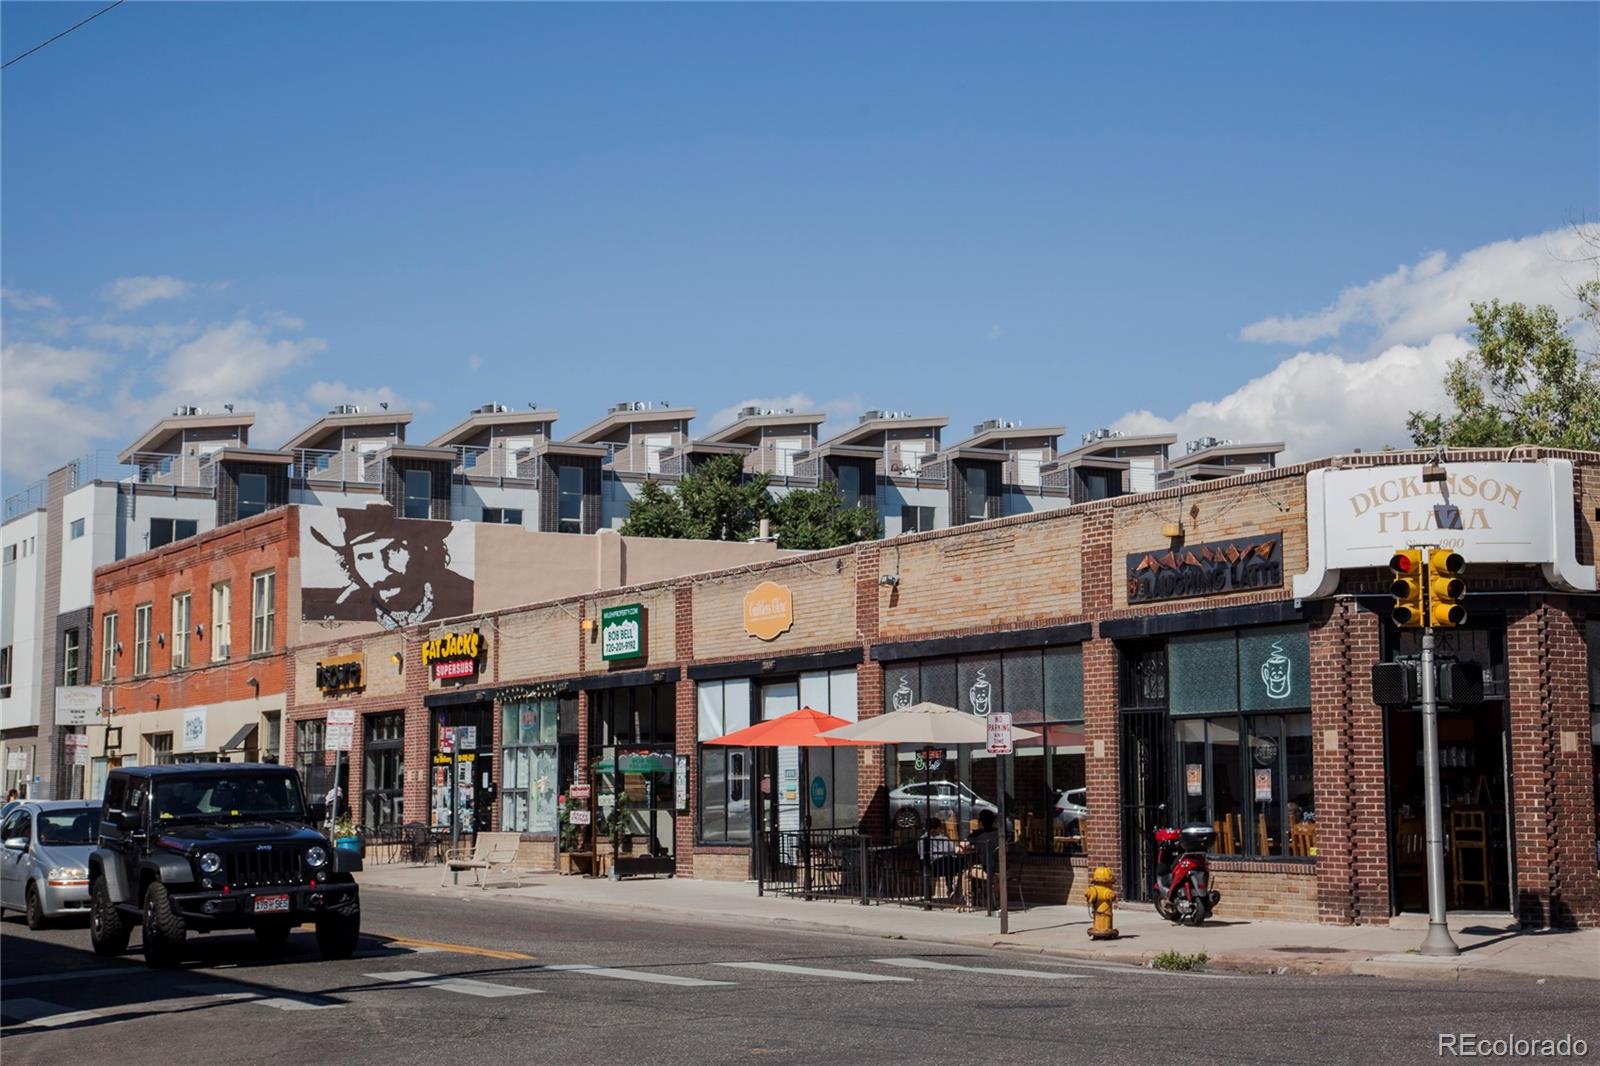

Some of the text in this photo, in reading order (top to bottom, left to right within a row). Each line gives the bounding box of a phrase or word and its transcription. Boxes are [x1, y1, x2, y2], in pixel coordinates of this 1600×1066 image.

[1349, 473, 1522, 517] DICKINSON
[1377, 508, 1492, 533] PLAZA
[1230, 561, 1280, 589] LATTE
[608, 629, 633, 641] BOB BELL
[422, 639, 441, 665] FAT
[436, 660, 473, 676] SUPERSUBS
[988, 723, 1009, 731] PARKING
